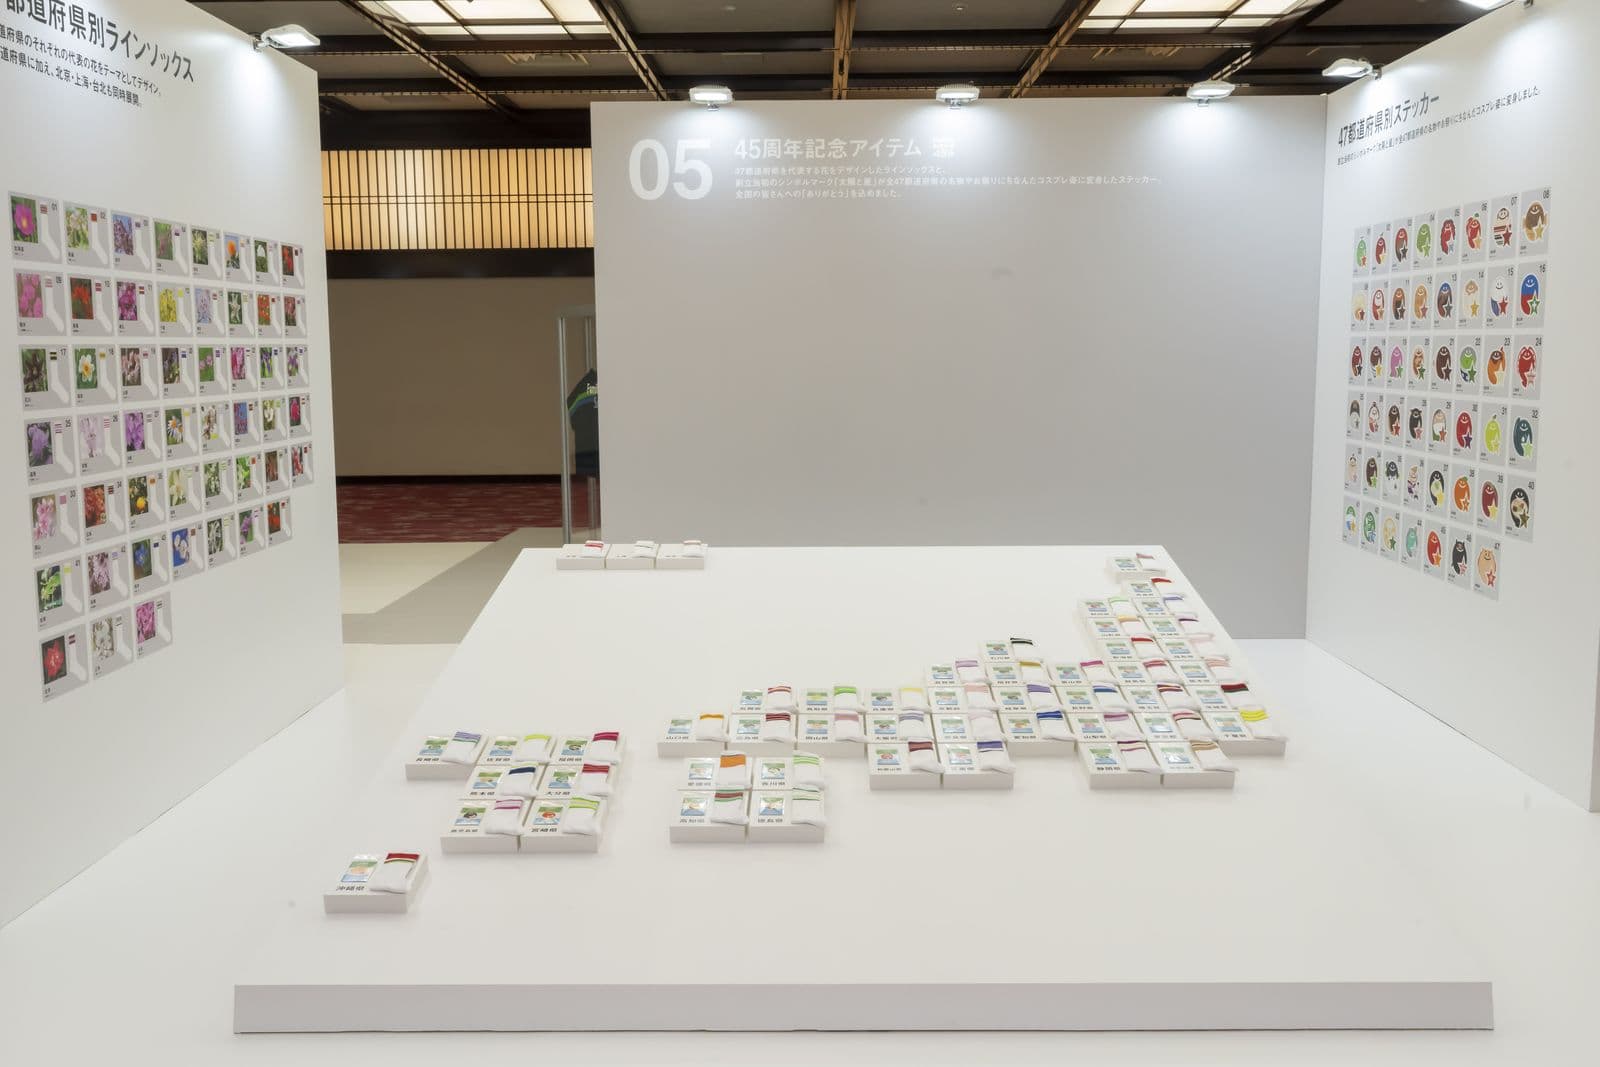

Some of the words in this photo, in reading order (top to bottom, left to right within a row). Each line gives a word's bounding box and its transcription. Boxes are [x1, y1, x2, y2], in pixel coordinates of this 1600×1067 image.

[1338, 91, 1439, 148] 47都道府県別ステッカー
[628, 138, 713, 200] 05
[735, 138, 922, 159] 45周年記念アイテム
